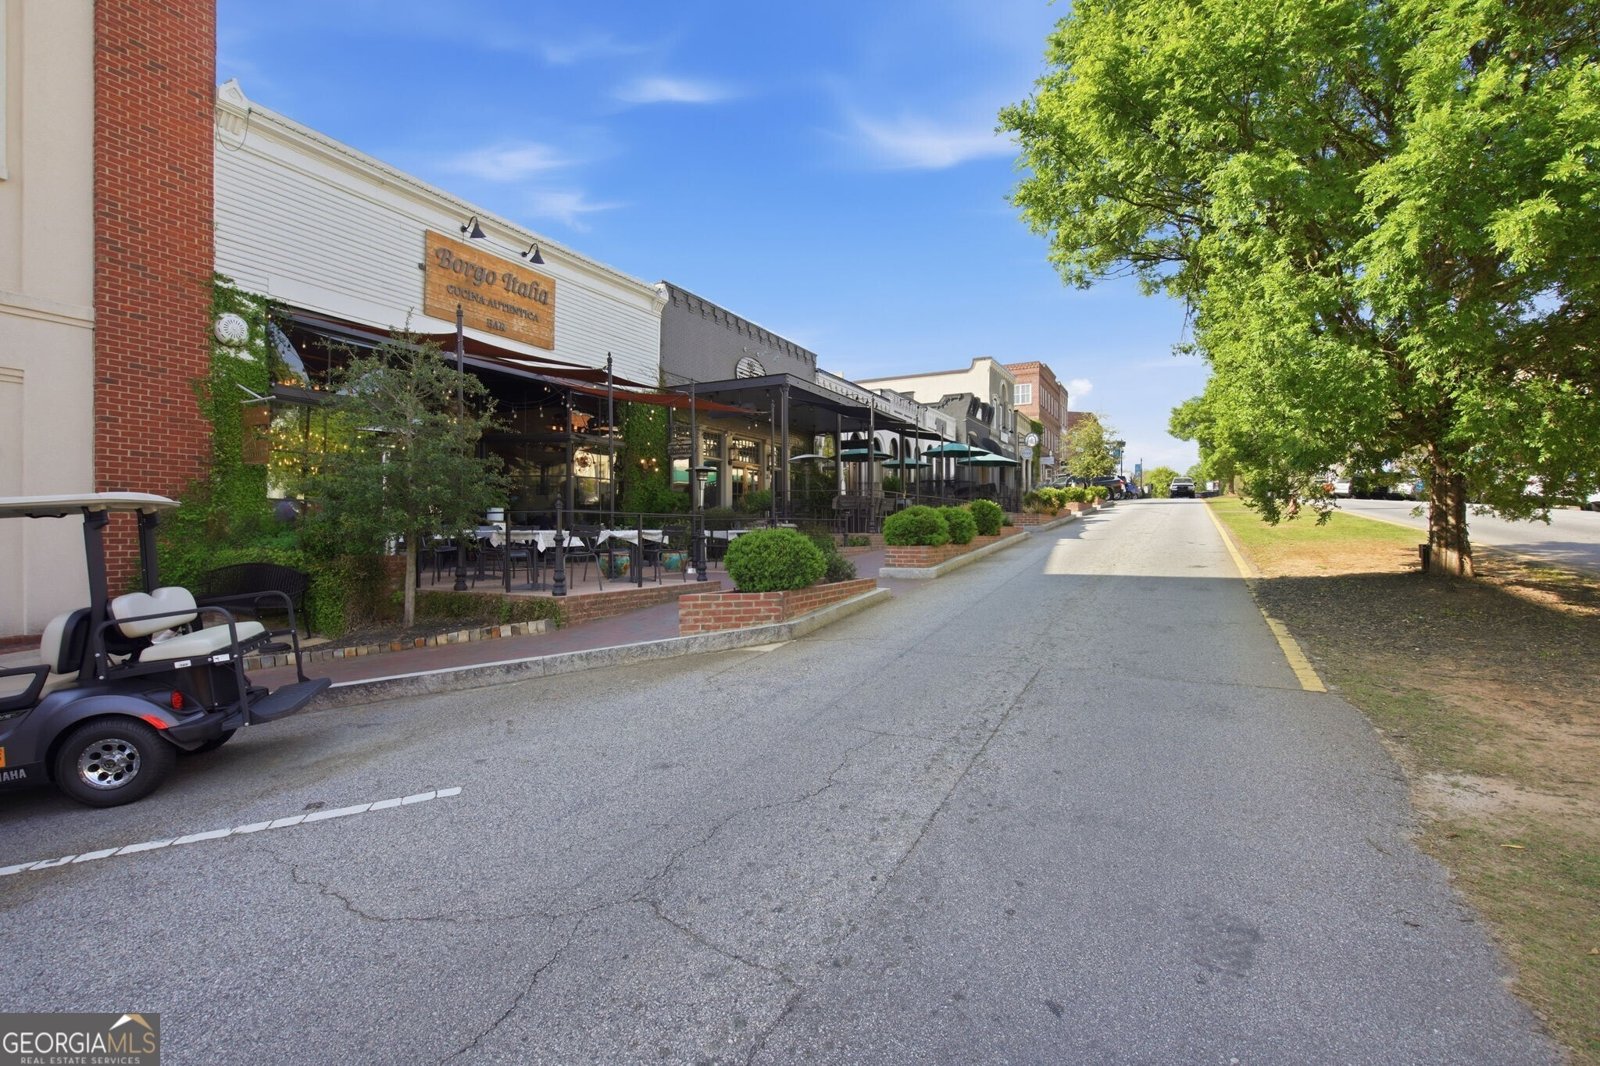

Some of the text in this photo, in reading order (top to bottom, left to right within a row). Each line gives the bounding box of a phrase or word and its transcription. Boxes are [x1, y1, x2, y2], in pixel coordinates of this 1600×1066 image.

[435, 247, 549, 305] Borgo Italia
[447, 284, 539, 322] CUCINA AUTENTICA
[486, 318, 506, 332] BAR
